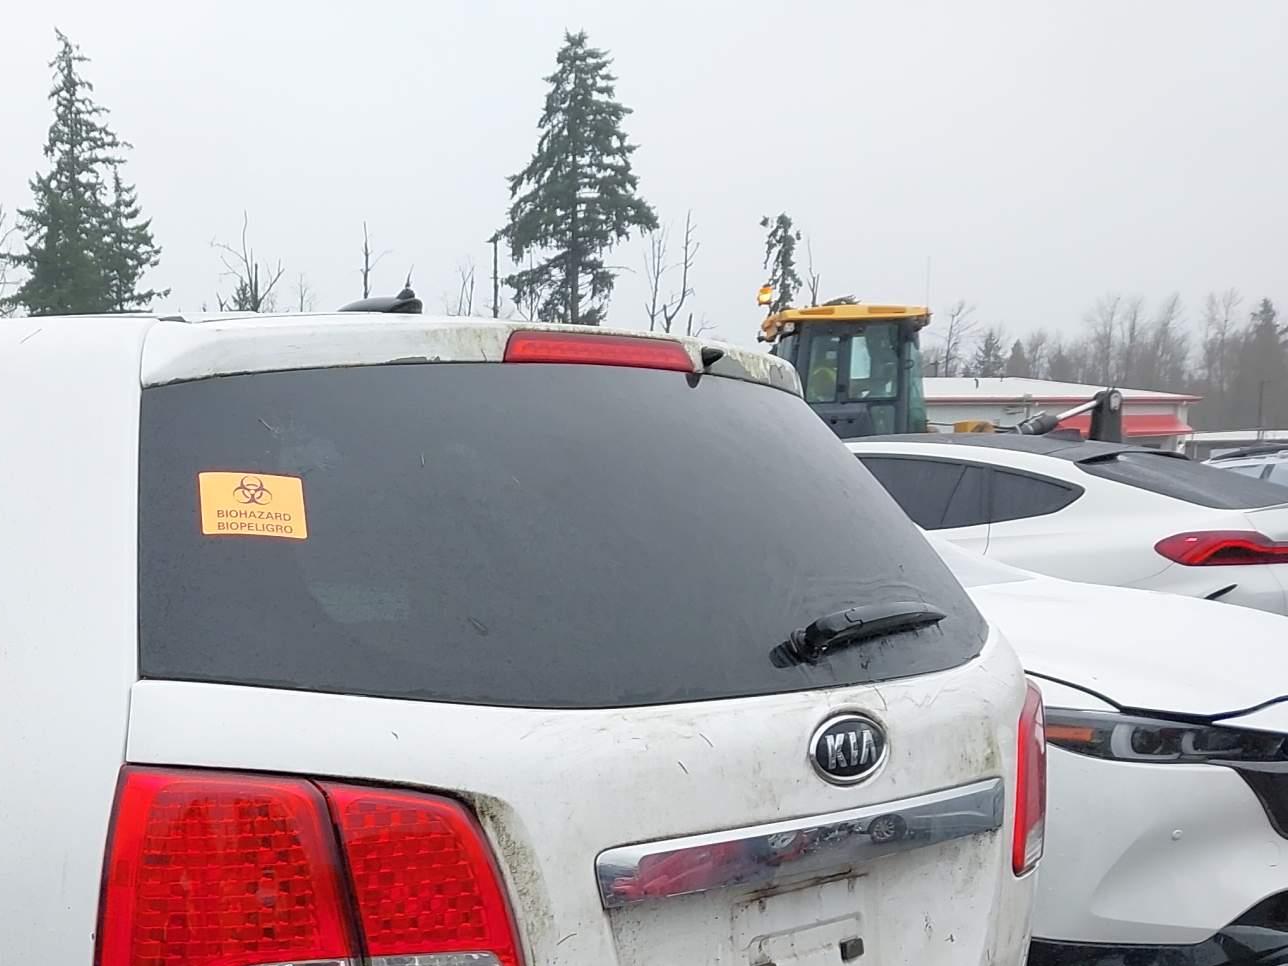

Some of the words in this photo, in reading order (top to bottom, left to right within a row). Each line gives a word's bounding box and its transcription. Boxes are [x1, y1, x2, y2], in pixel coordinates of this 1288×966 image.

[216, 509, 292, 522] BIOHAZARD
[217, 521, 293, 534] BIOPELIGRO
[825, 729, 877, 770] KIA
